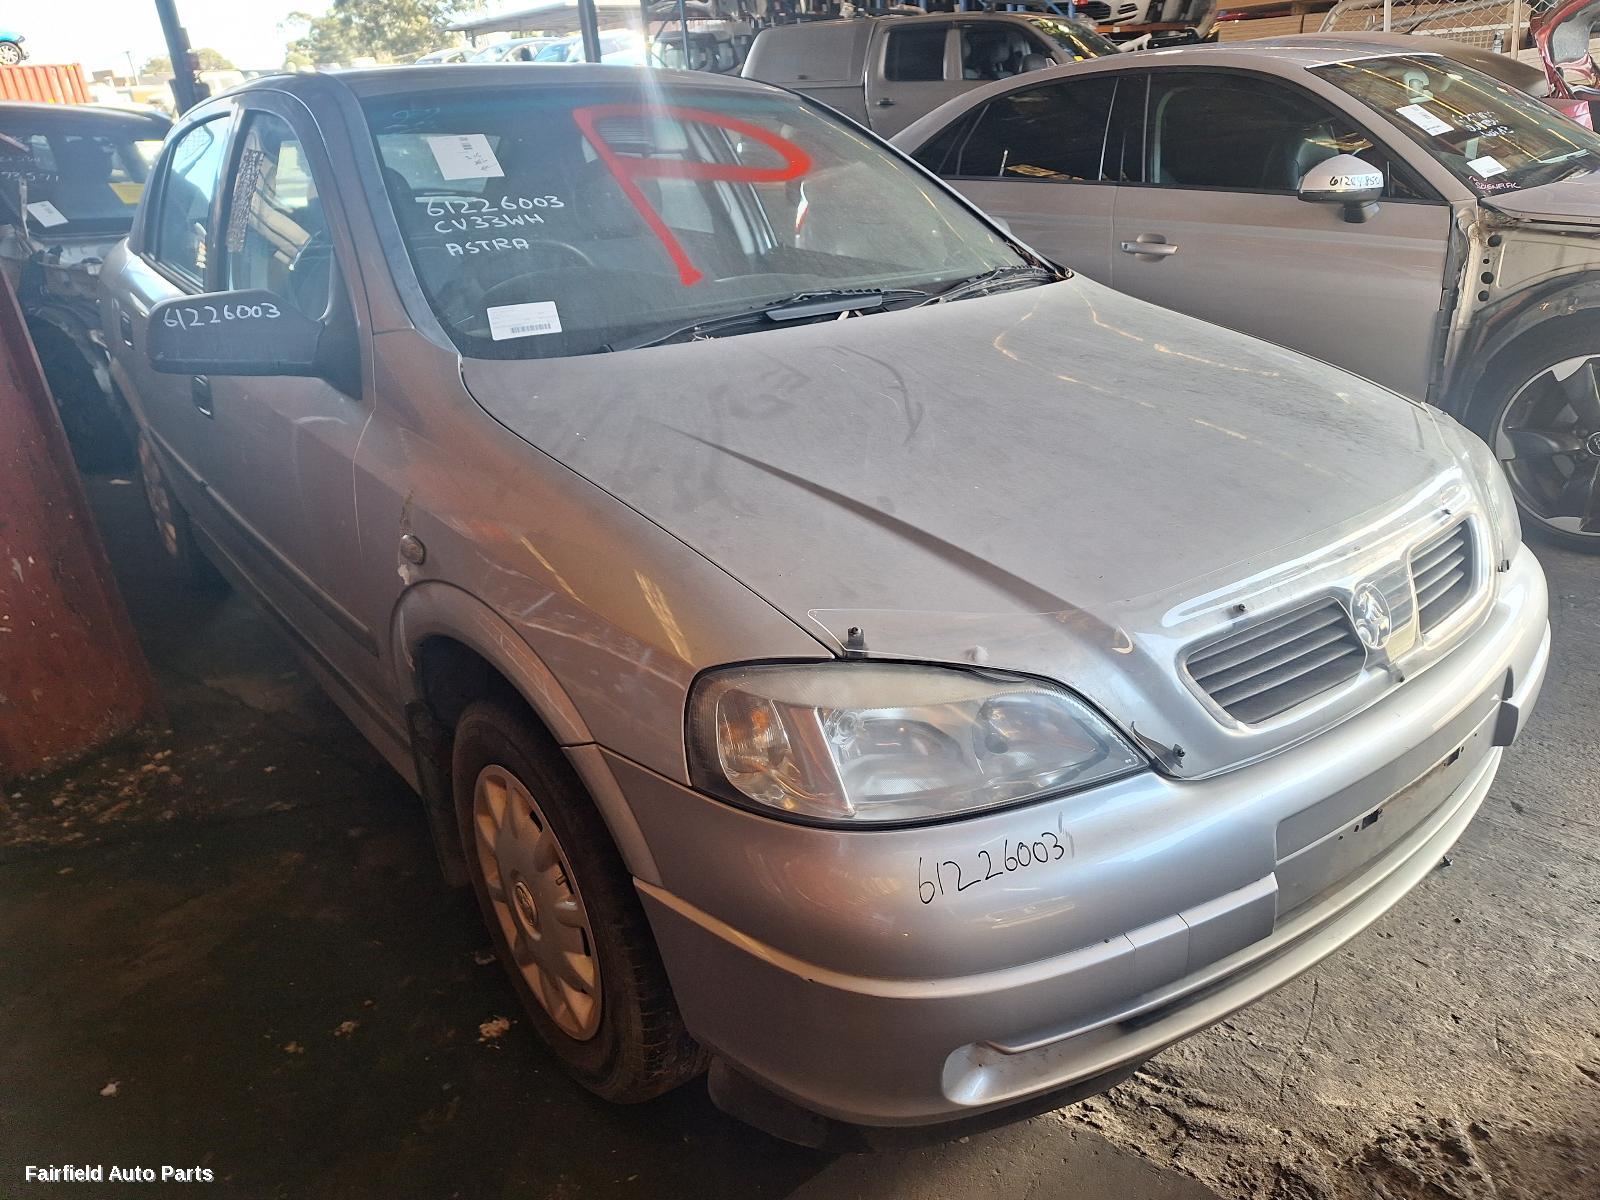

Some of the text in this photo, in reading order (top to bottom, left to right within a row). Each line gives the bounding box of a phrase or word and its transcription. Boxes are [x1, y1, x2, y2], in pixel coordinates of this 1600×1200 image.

[426, 195, 565, 217] 61226003
[572, 104, 813, 286] P
[434, 213, 545, 233] CV33WH
[445, 237, 530, 257] ASTRA
[162, 302, 281, 330] 61226003
[917, 831, 1065, 905] 61226003
